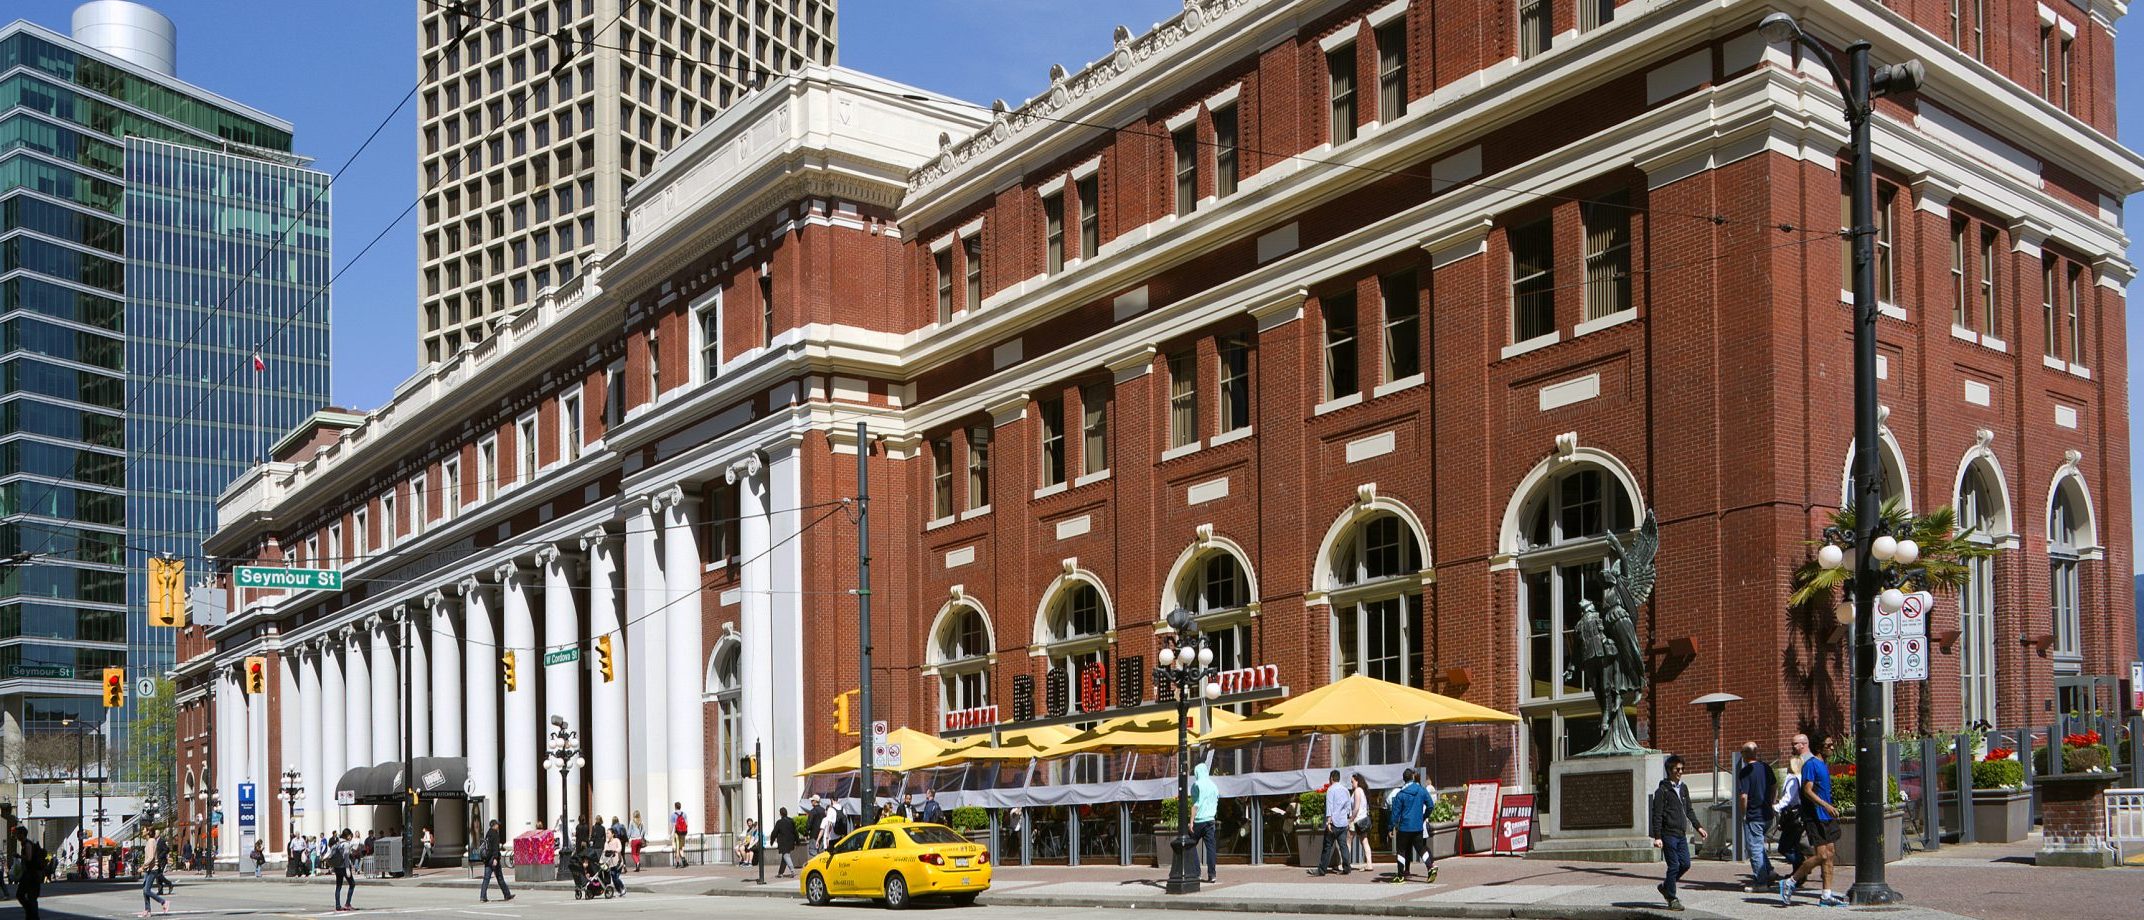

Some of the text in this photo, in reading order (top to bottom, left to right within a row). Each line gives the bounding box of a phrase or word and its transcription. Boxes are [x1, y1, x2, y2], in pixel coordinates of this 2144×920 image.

[241, 569, 335, 585] Seymour St
[551, 653, 571, 663] Cordova
[572, 650, 578, 660] St
[13, 666, 70, 677] Seymour St
[1013, 656, 1178, 722] ROGUE
[945, 704, 998, 730] KITCHEN
[1503, 821, 1512, 838] 3
